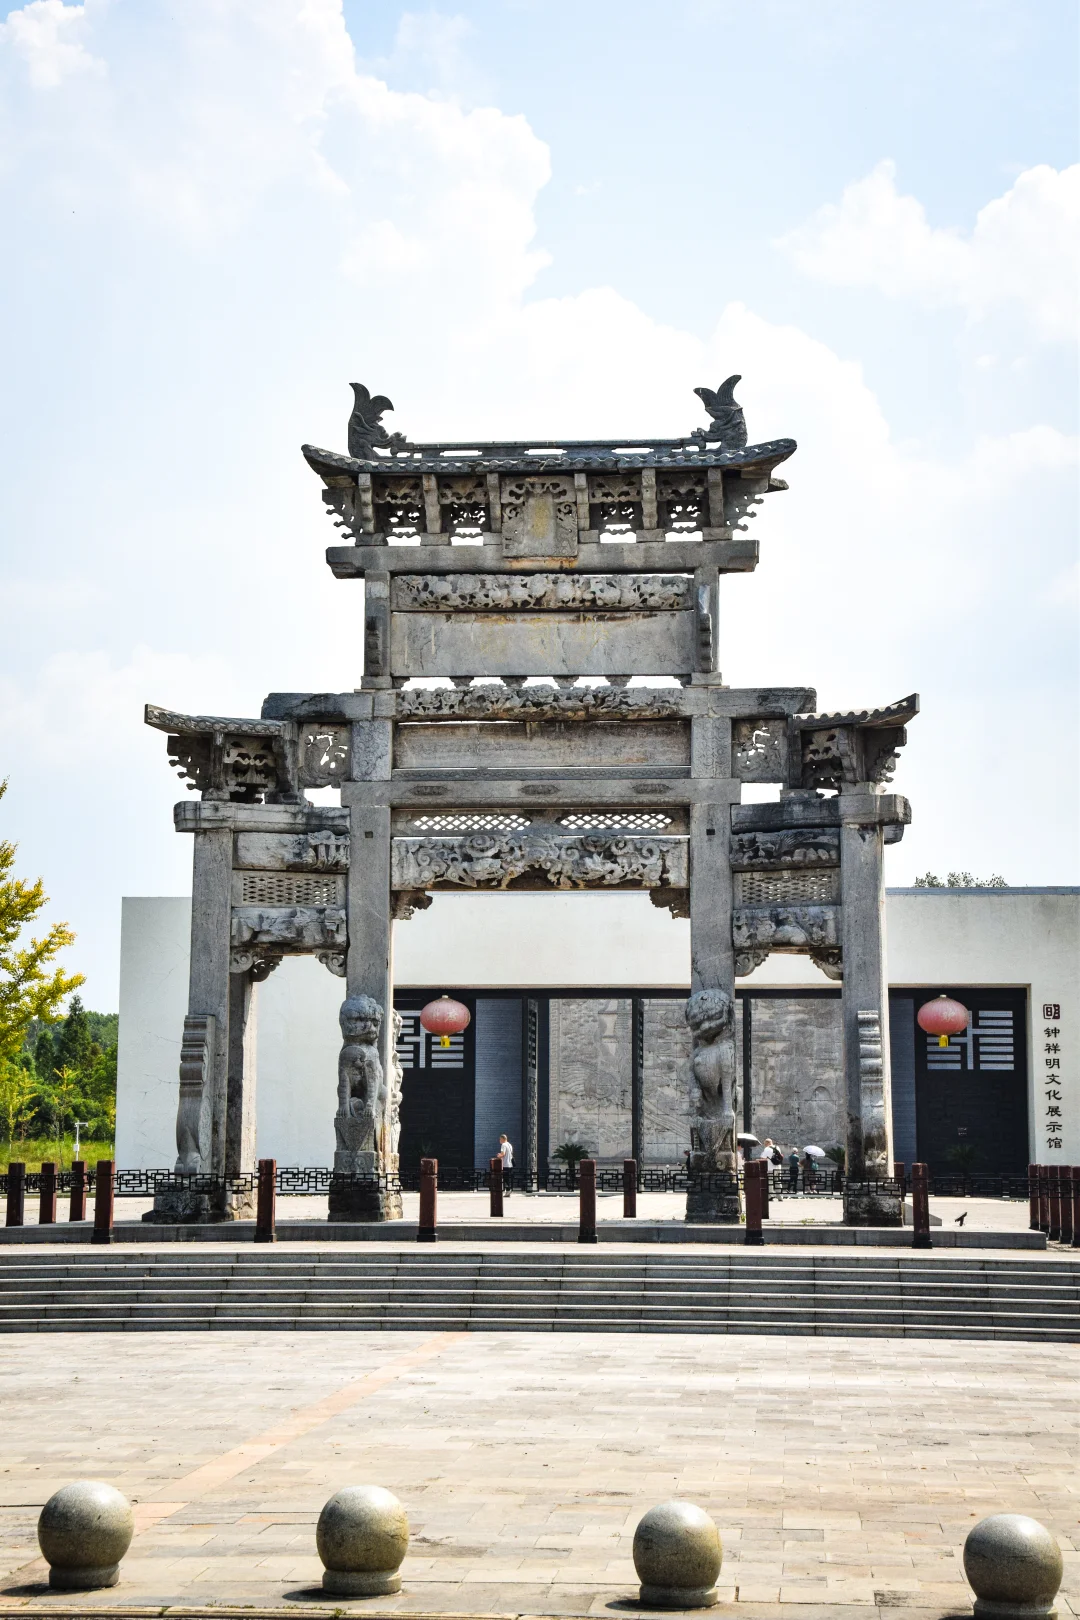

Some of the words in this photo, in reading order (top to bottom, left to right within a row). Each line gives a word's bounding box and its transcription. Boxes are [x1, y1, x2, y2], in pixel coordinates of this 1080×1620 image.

[1044, 1027, 1062, 1148] 钟祥明文化展示馆
